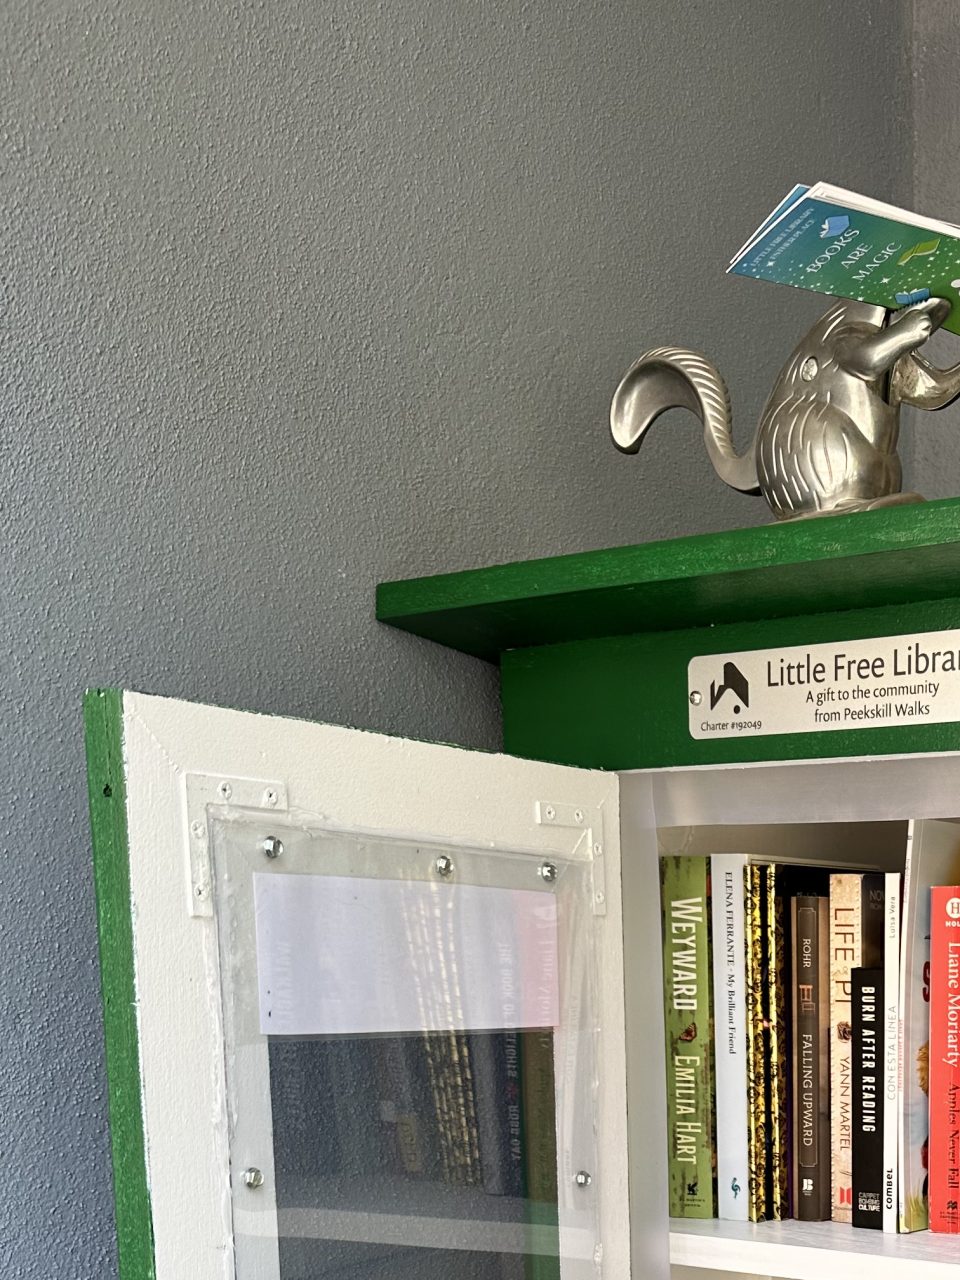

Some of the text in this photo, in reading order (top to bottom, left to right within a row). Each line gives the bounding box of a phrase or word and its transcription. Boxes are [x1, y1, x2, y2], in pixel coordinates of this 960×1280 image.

[806, 229, 860, 274] BOOKS
[841, 242, 873, 269] ARE
[852, 242, 902, 281] MAGIC
[767, 654, 825, 687] Little
[833, 654, 885, 682] Free
[806, 681, 940, 707] A gift to the community
[814, 703, 930, 723] from Peekskill Walks
[700, 720, 762, 732] Charter #192049
[725, 872, 735, 966] ELENA FERRANTE
[834, 908, 855, 961] LIFE
[671, 897, 703, 1010] WEYWARD
[803, 938, 811, 968] ROHR
[835, 980, 851, 1002] PI
[727, 974, 737, 1054] My Brilliant Friend
[862, 986, 876, 1132] BURN AFTER READING
[887, 1044, 897, 1072] ESTA
[803, 1034, 813, 1147] FALLING UPWARD
[839, 1056, 851, 1151] YANN MARTEL
[888, 1075, 897, 1101] CON
[675, 1055, 702, 1165] EMILIA HART
[948, 1083, 960, 1189] Apples Never Fall
